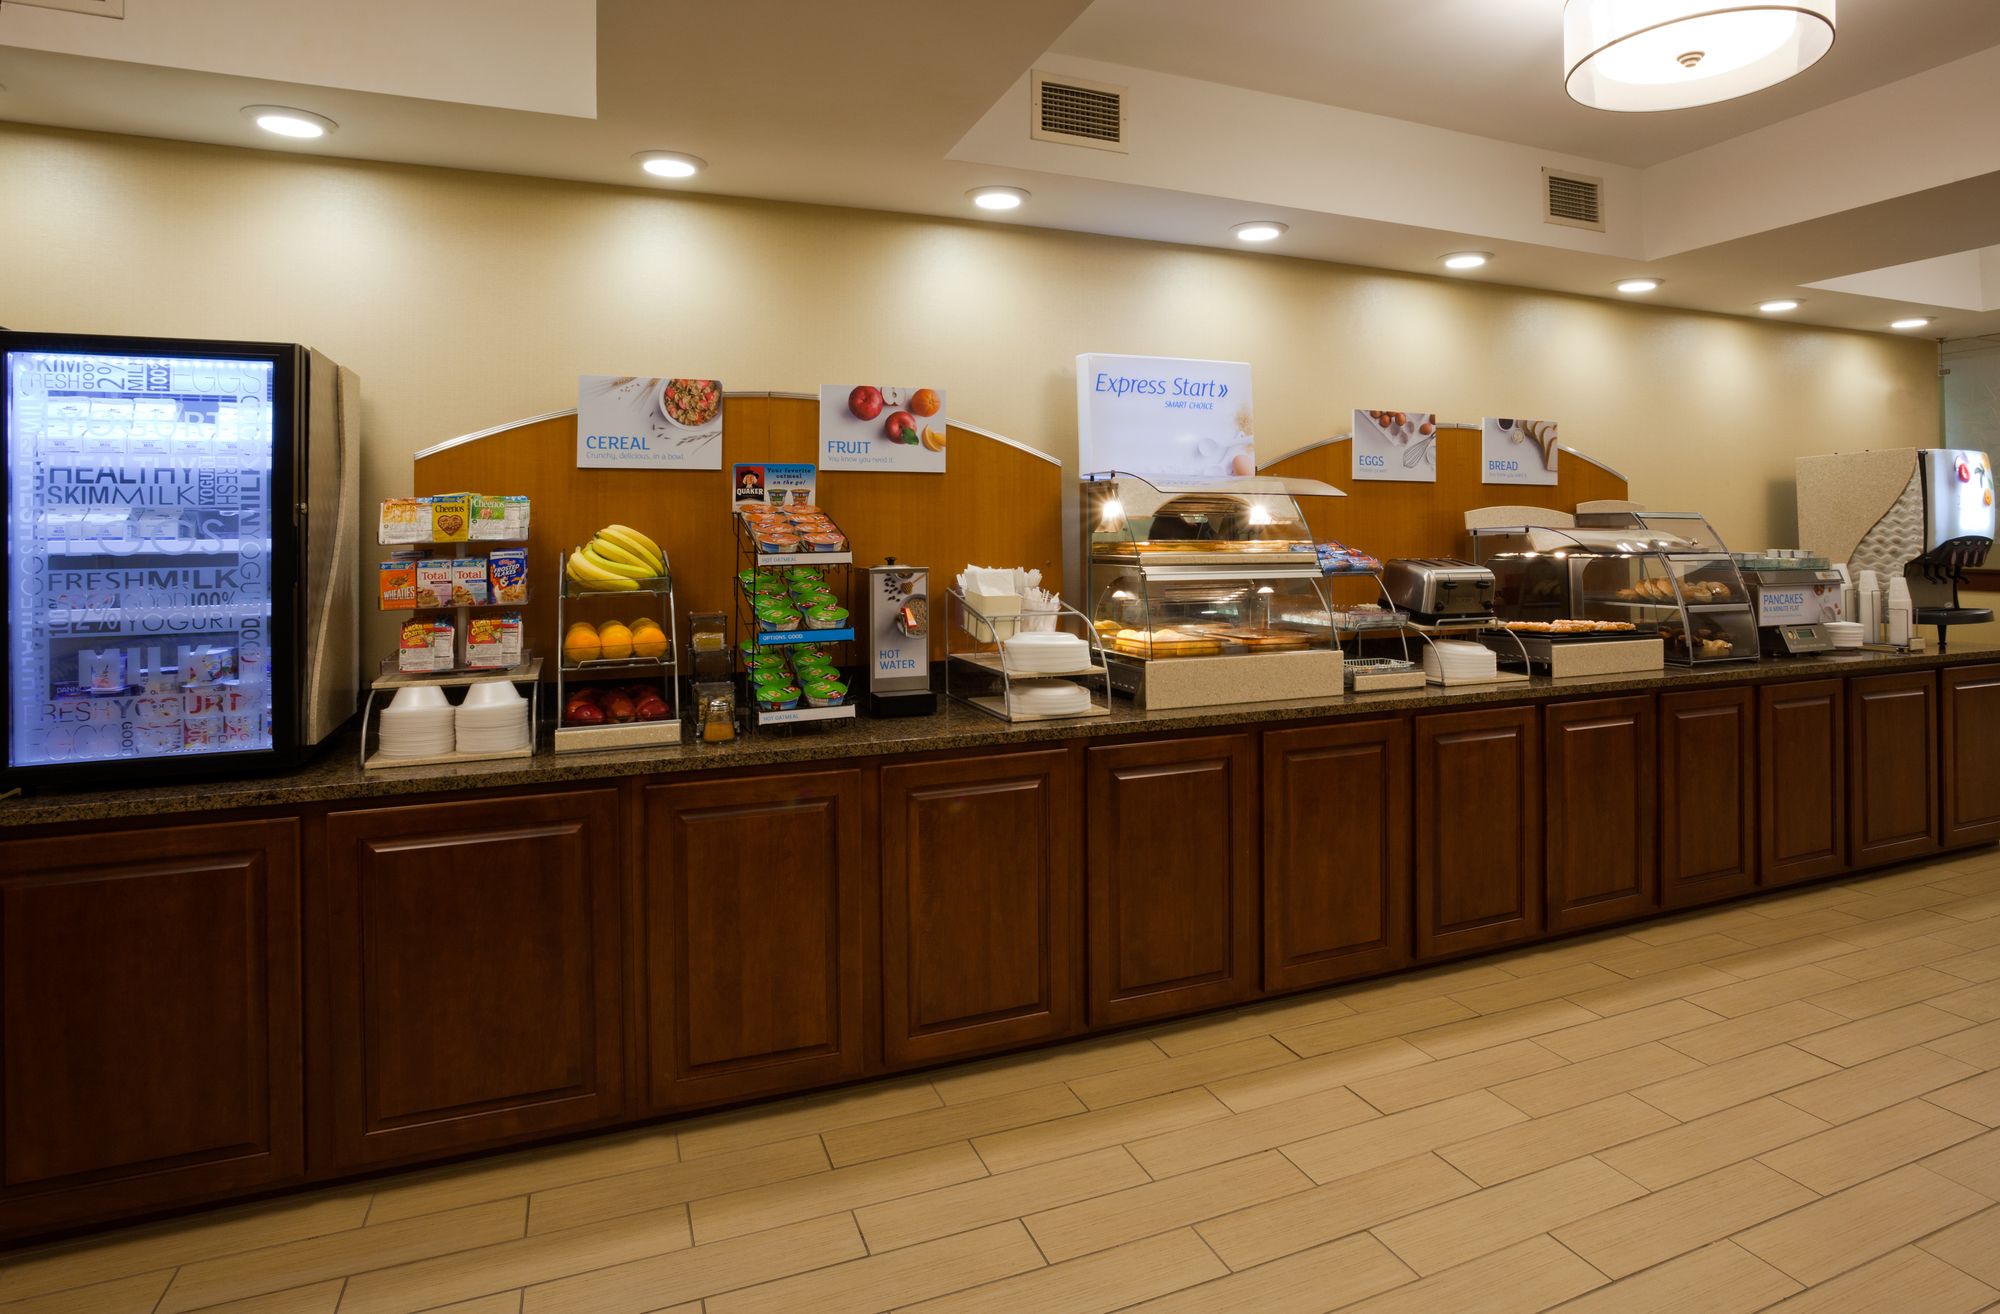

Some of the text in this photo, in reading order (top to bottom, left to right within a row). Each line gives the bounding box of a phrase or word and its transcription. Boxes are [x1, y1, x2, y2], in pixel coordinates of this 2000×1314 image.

[1096, 373, 1166, 398] Express
[1165, 401, 1214, 410] SMART CHOICE
[586, 435, 651, 450] CEREAL
[828, 440, 871, 454] FRUIT
[1359, 455, 1384, 466] EGGS
[1488, 460, 1519, 471] BREAD
[49, 455, 197, 485] HEALTHY
[736, 487, 764, 496] QUAKER
[435, 504, 465, 514] Cheerios
[421, 571, 448, 580] Total
[456, 570, 482, 579] Total
[384, 586, 415, 600] WHEATIES
[1763, 593, 1804, 605] PANCAKES
[879, 649, 900, 660] HOT
[880, 659, 916, 670] WATER
